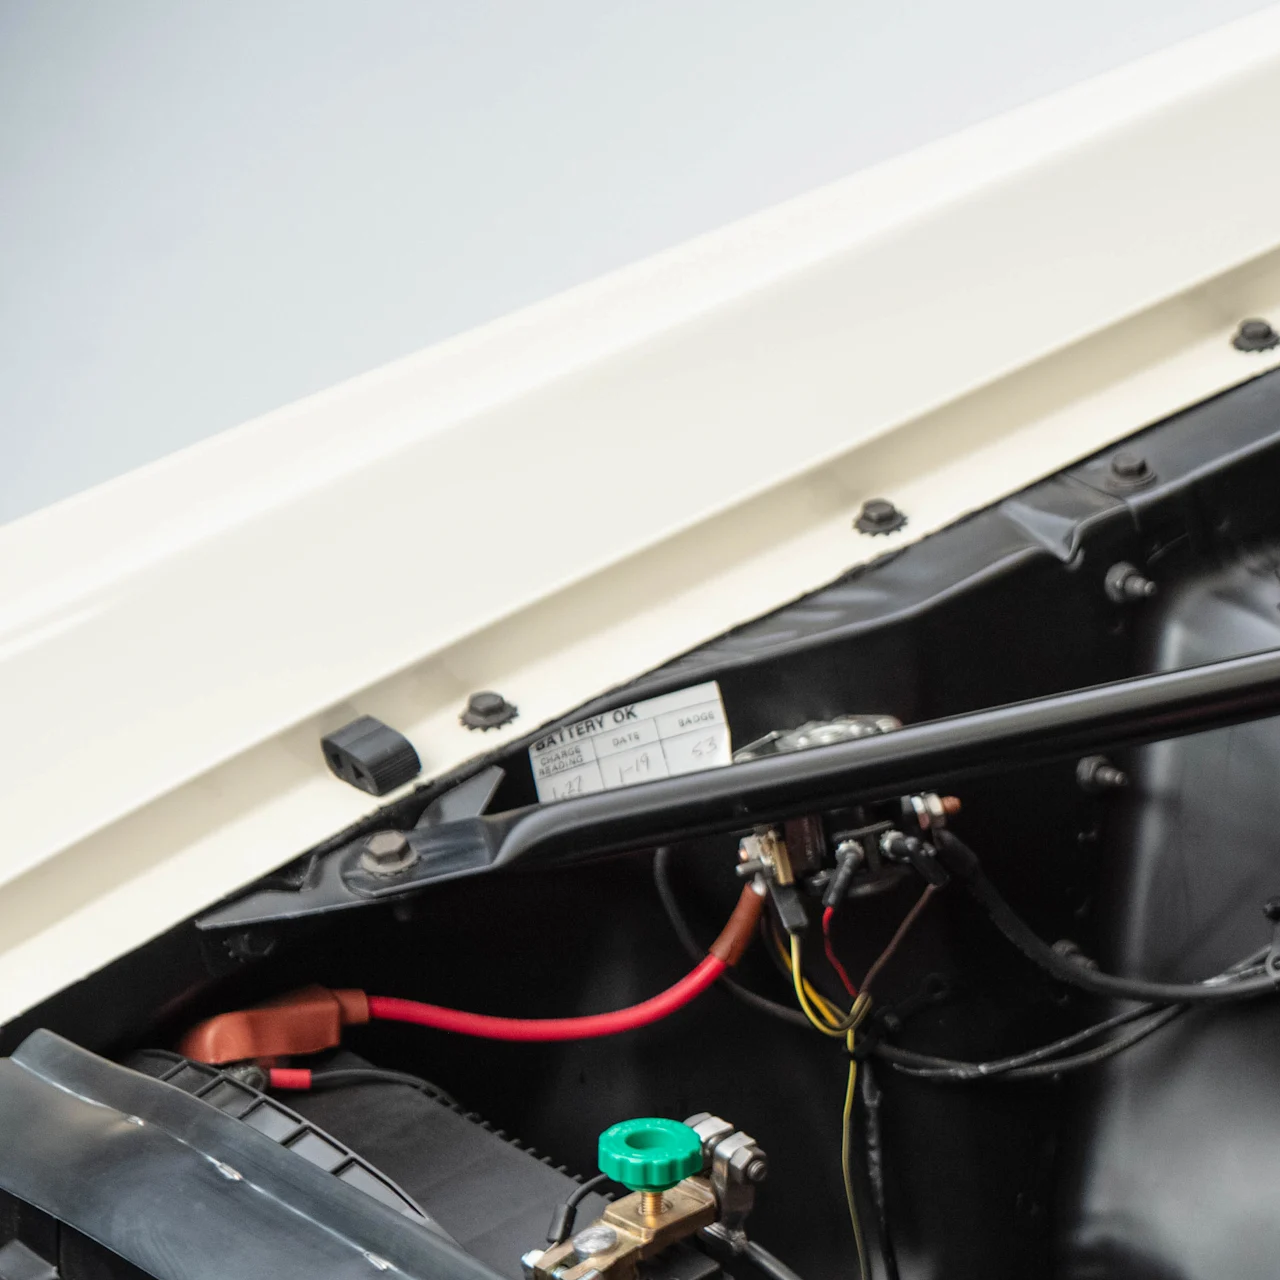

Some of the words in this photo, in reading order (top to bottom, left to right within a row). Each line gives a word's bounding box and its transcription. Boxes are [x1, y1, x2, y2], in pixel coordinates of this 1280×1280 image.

[536, 715, 605, 752] BATTERY
[613, 704, 639, 723] OK
[678, 711, 715, 728] BADGE
[612, 733, 641, 747] DATE
[538, 755, 584, 777] READING
[540, 745, 582, 766] CHARGE
